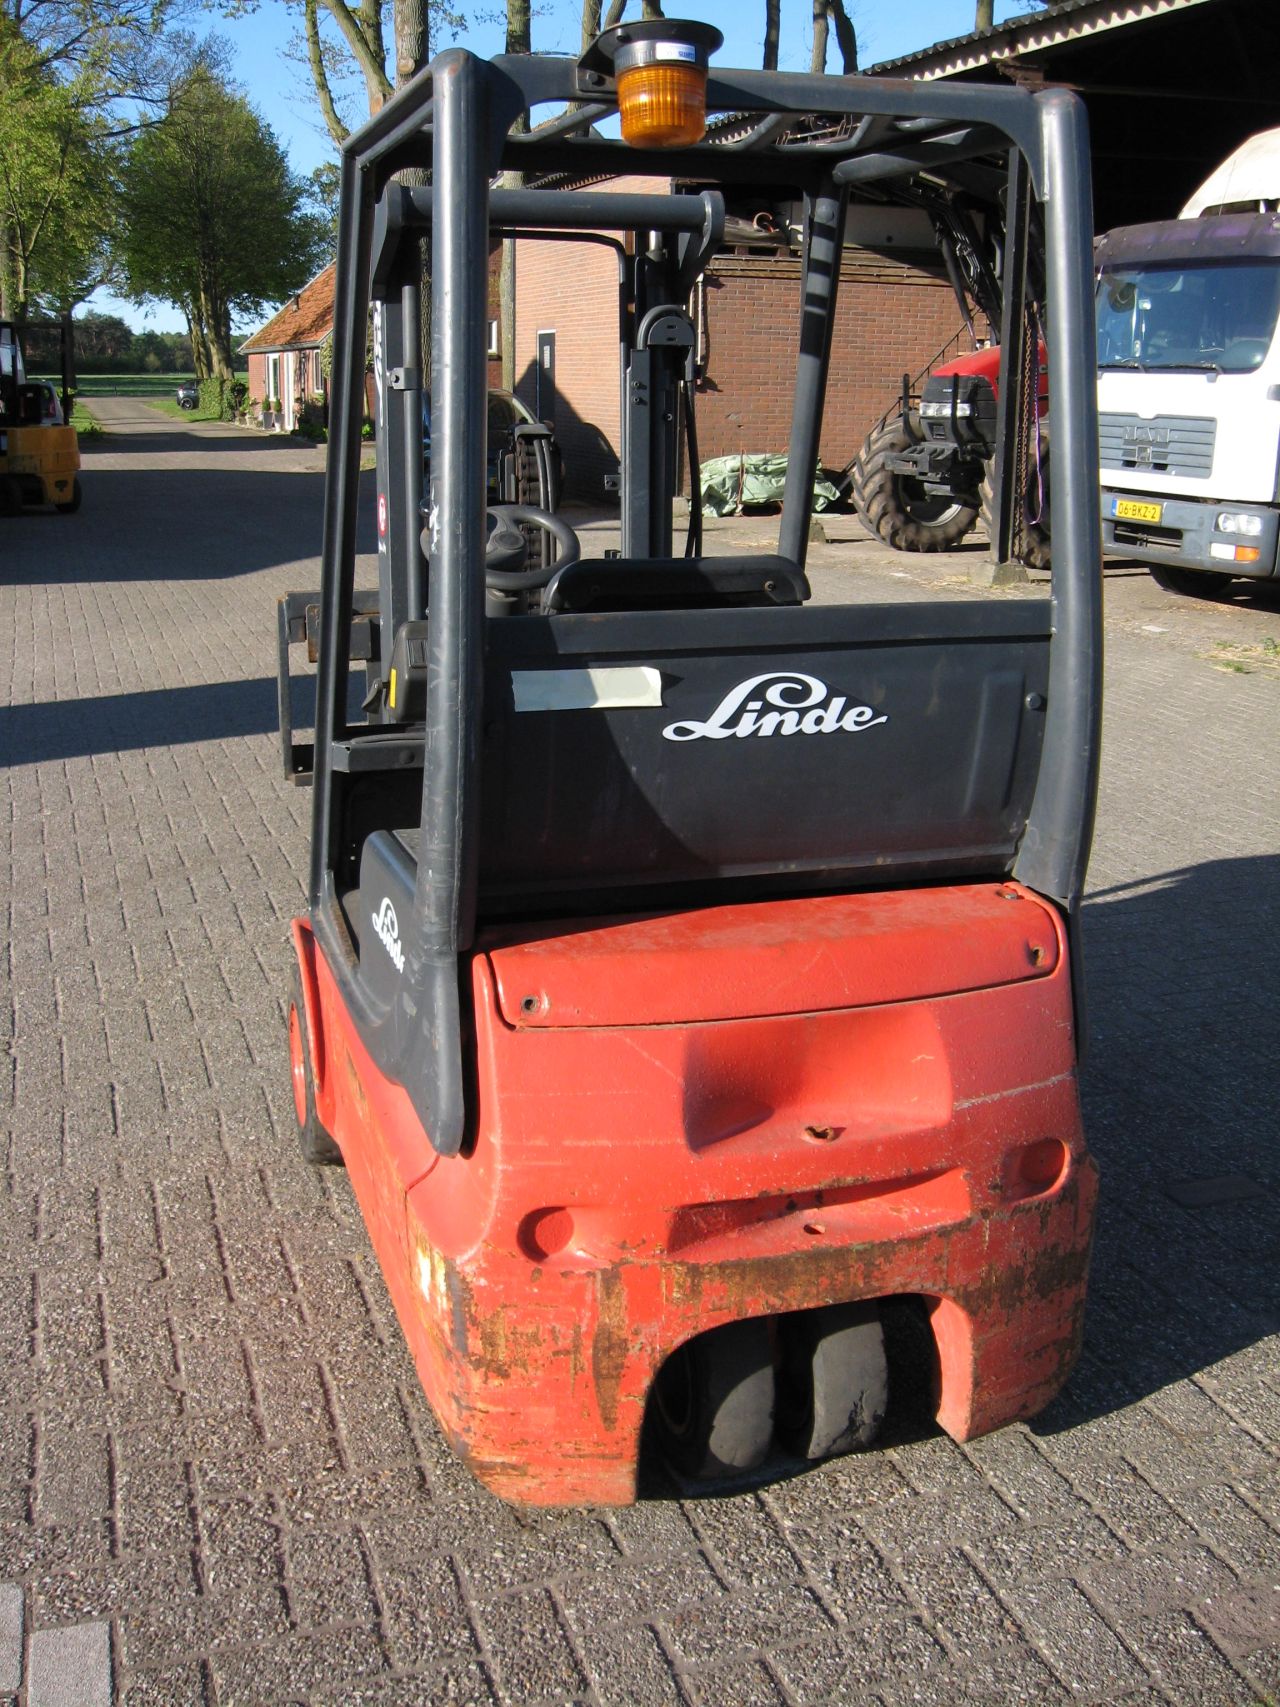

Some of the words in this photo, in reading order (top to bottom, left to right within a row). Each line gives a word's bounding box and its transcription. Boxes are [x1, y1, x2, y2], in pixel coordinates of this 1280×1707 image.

[1123, 426, 1170, 442] MAN
[1118, 503, 1157, 519] 06-BKZ-2
[662, 672, 888, 741] Linde
